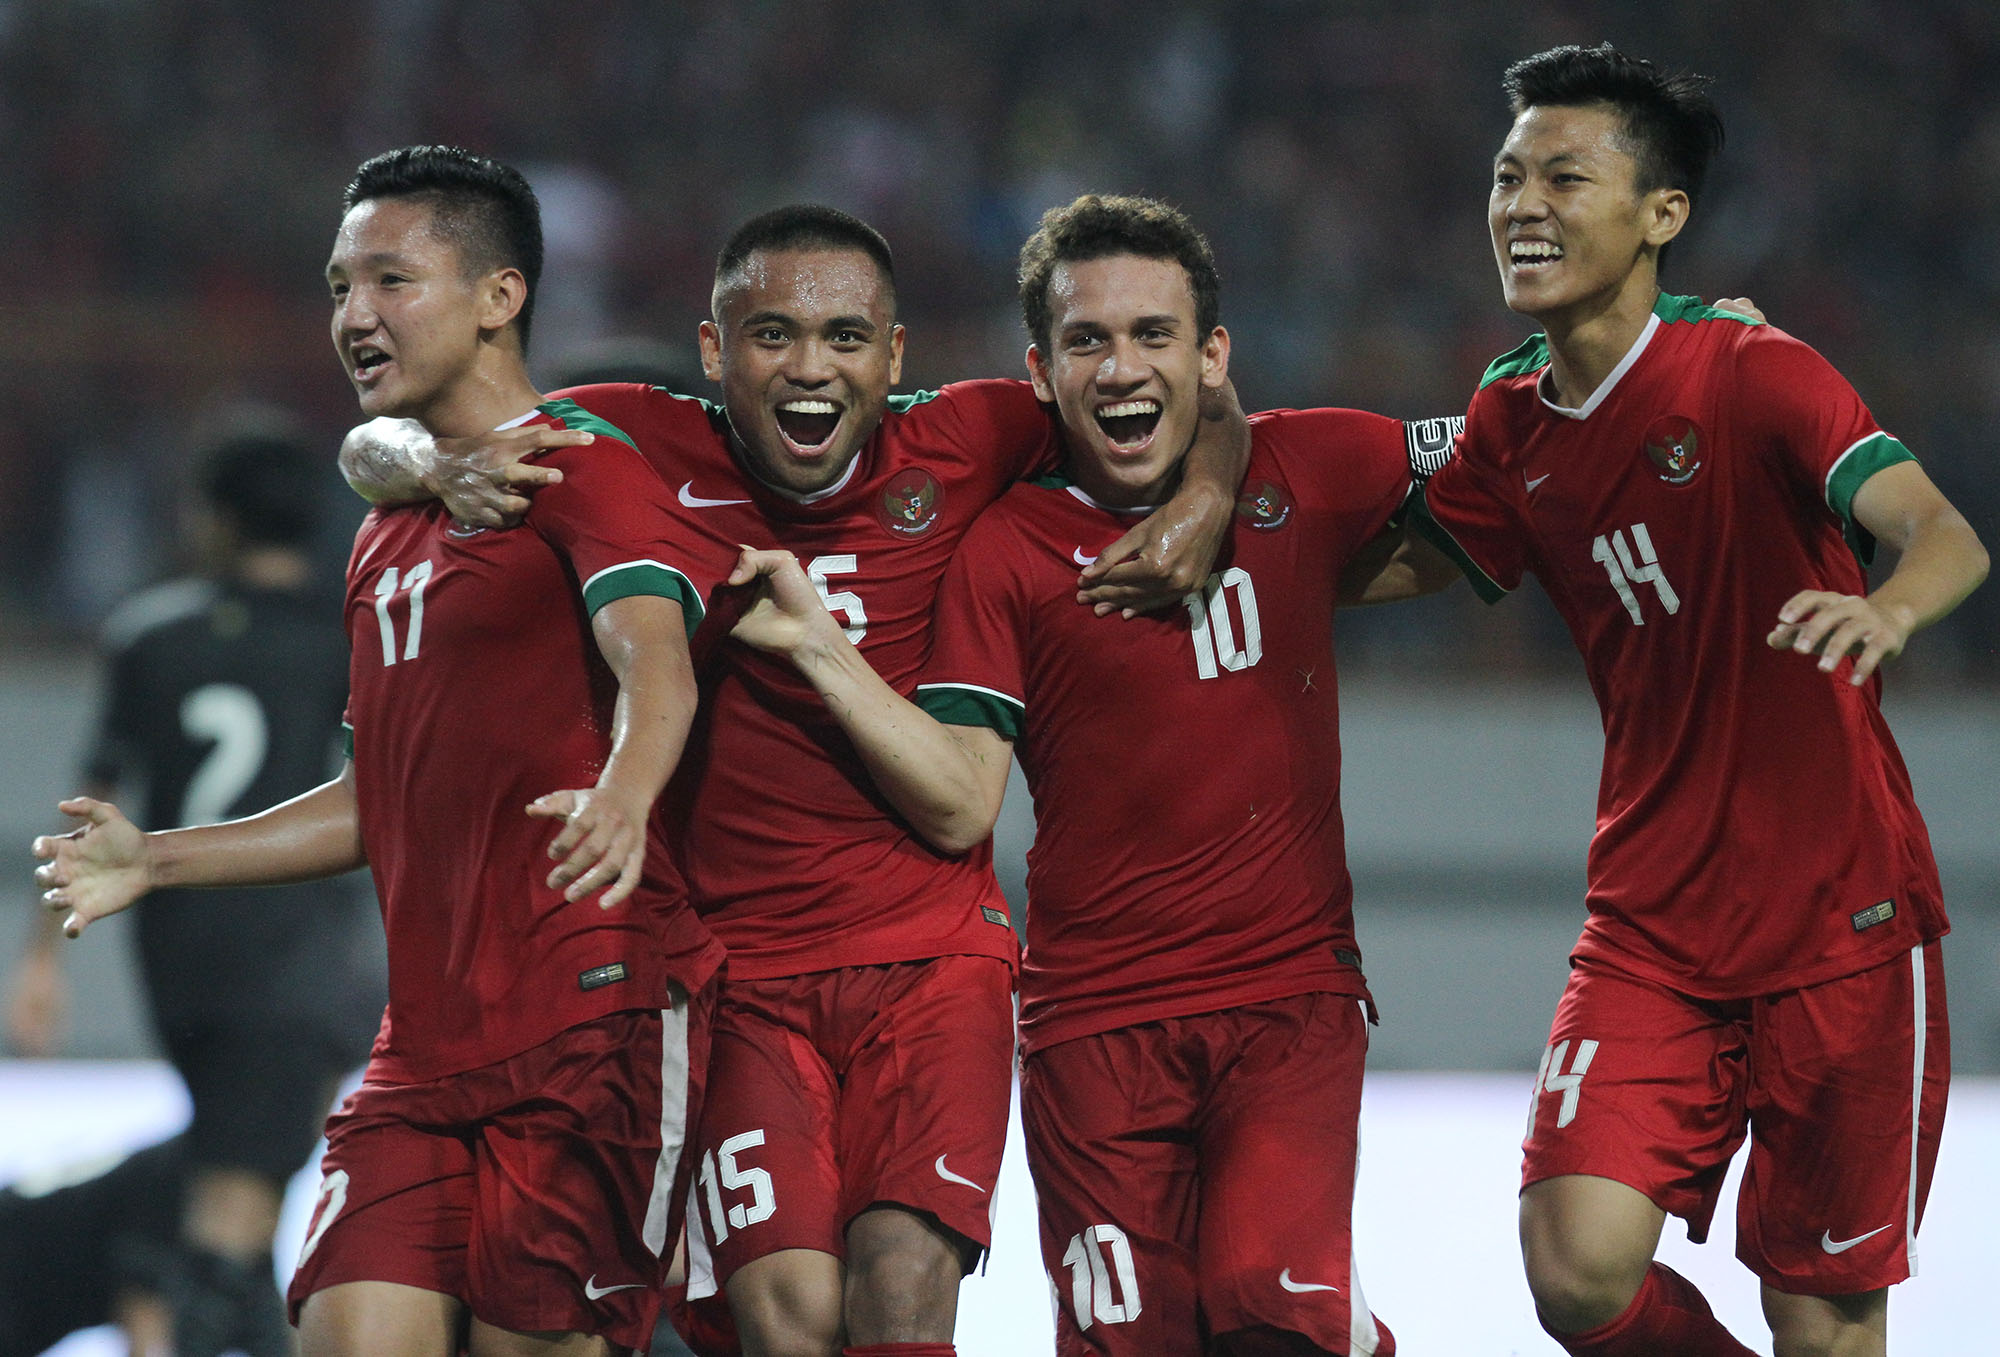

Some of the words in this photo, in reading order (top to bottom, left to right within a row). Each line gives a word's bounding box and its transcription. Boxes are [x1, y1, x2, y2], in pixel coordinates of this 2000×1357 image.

[374, 559, 433, 667] 17
[1182, 567, 1262, 679] 10
[1592, 523, 1680, 625] 14
[179, 683, 268, 828] 2
[1527, 1039, 1600, 1141] 14
[699, 1129, 777, 1246] 15
[1062, 1224, 1142, 1332] 10
